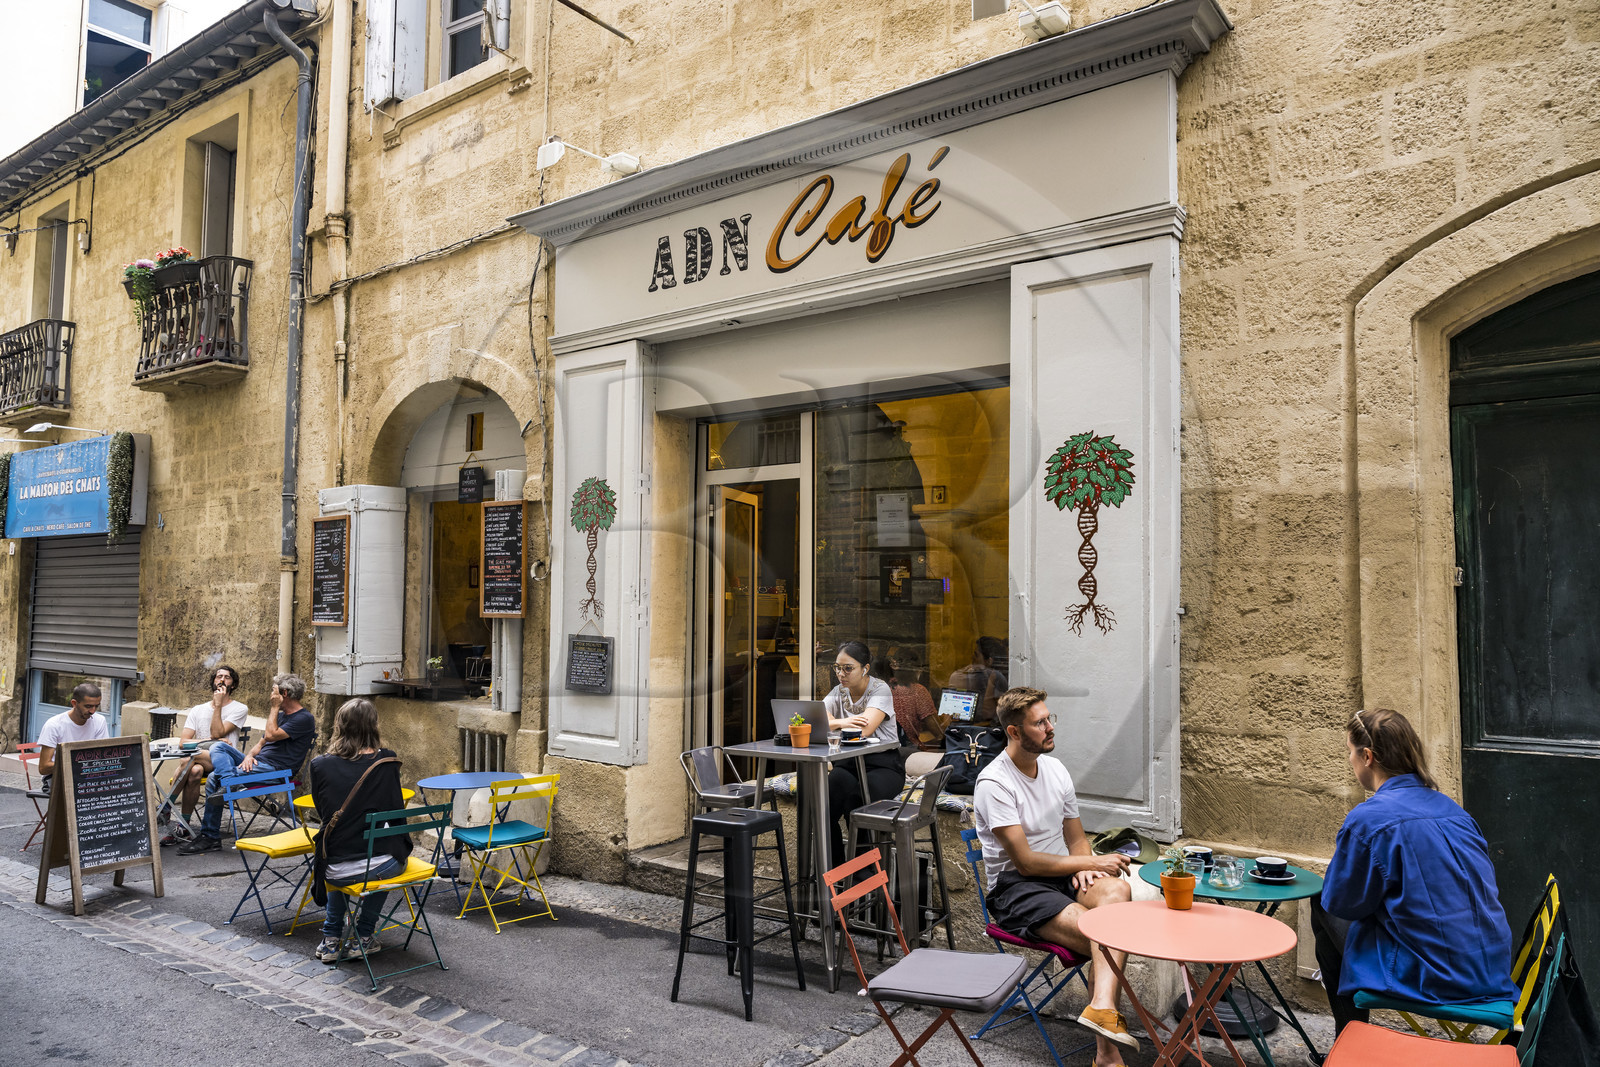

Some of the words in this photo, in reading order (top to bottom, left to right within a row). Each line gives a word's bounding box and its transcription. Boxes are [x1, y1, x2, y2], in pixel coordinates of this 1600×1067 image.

[648, 213, 753, 292] ADN
[765, 145, 950, 274] Café
[20, 486, 28, 500] LA
[30, 481, 59, 498] MAISON
[60, 480, 73, 495] DES
[76, 476, 101, 494] CHATS
[157, 512, 164, 531] 4
